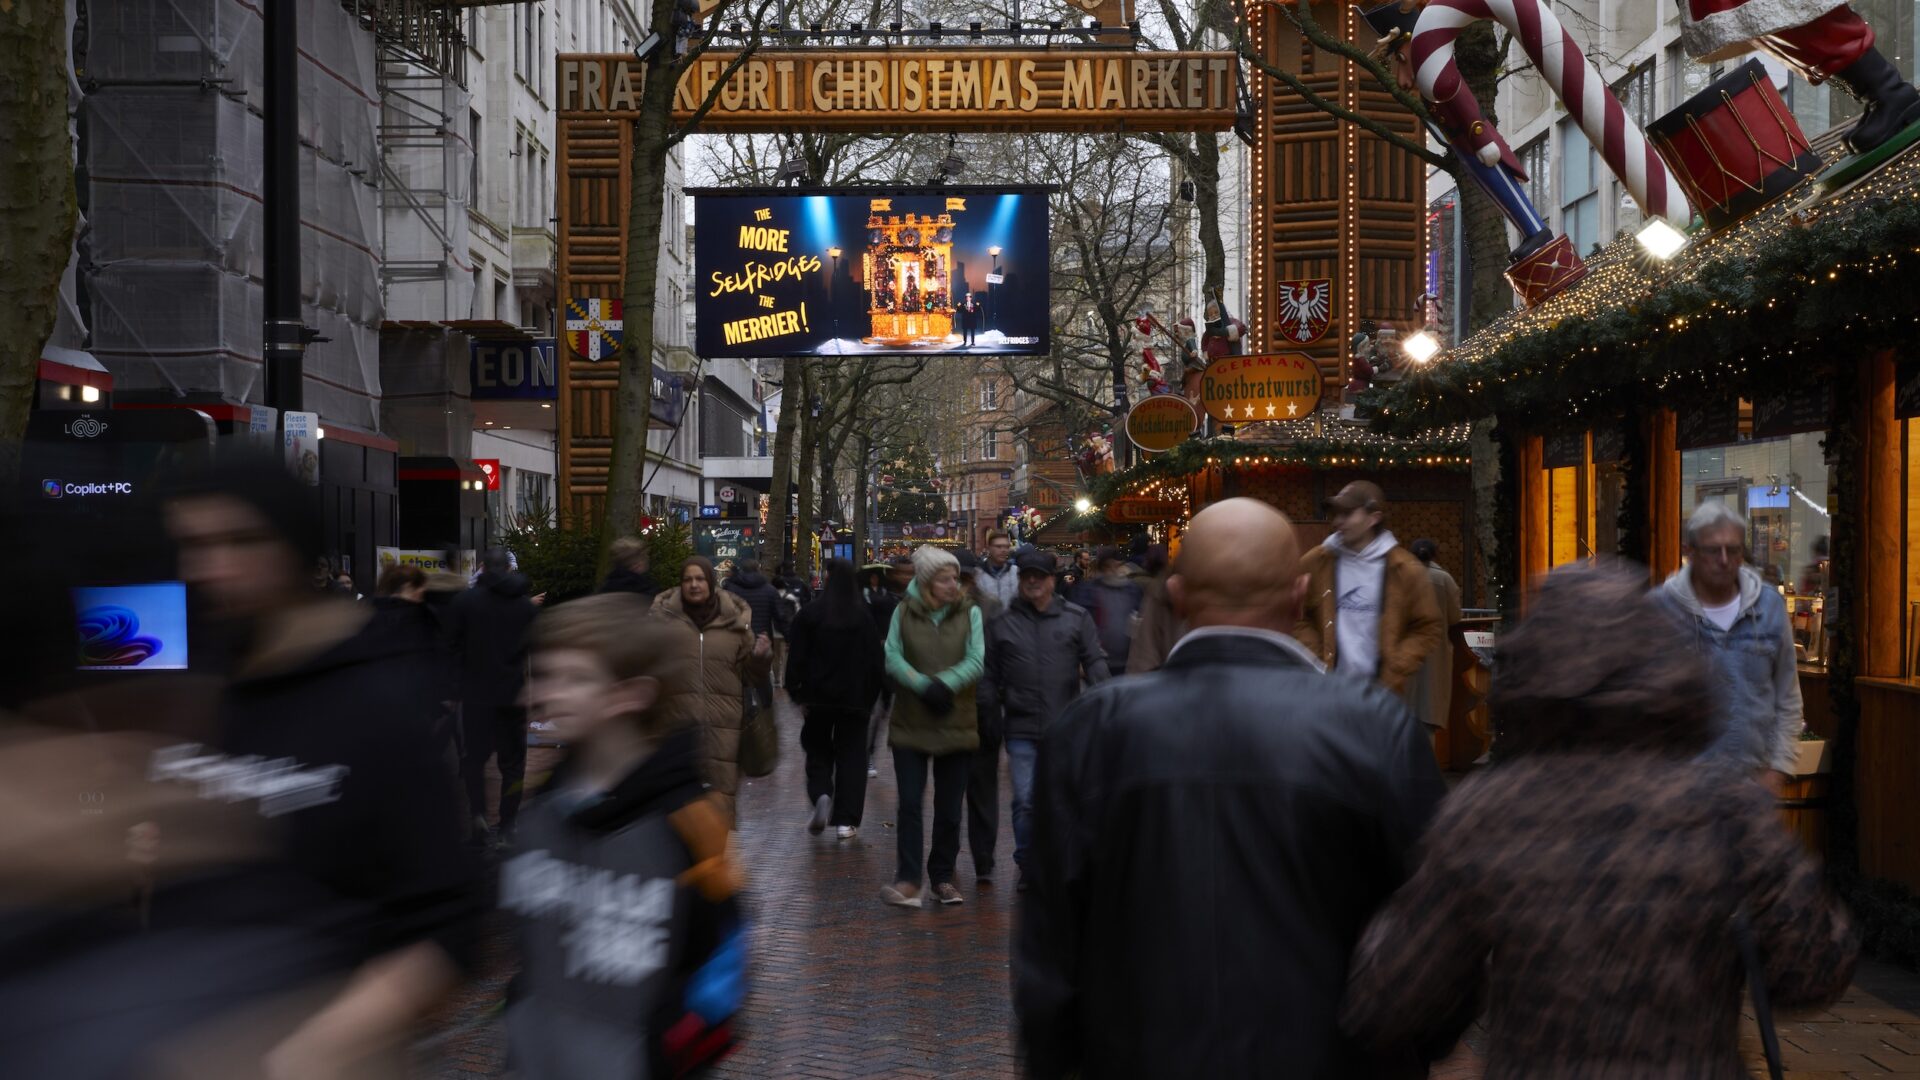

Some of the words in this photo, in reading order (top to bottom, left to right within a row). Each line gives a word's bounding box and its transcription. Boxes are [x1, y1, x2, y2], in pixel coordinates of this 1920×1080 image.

[561, 60, 793, 111] FRAKFURT
[812, 59, 1038, 111] CHRISTMAS
[1062, 59, 1230, 110] MARKET
[754, 207, 772, 222] THE
[738, 225, 790, 253] MORE
[759, 295, 776, 309] THE
[723, 302, 810, 345] MERRIER!
[476, 345, 554, 387] EON
[1217, 358, 1306, 373] GERMAN
[1204, 374, 1318, 401] Rostbratwurst
